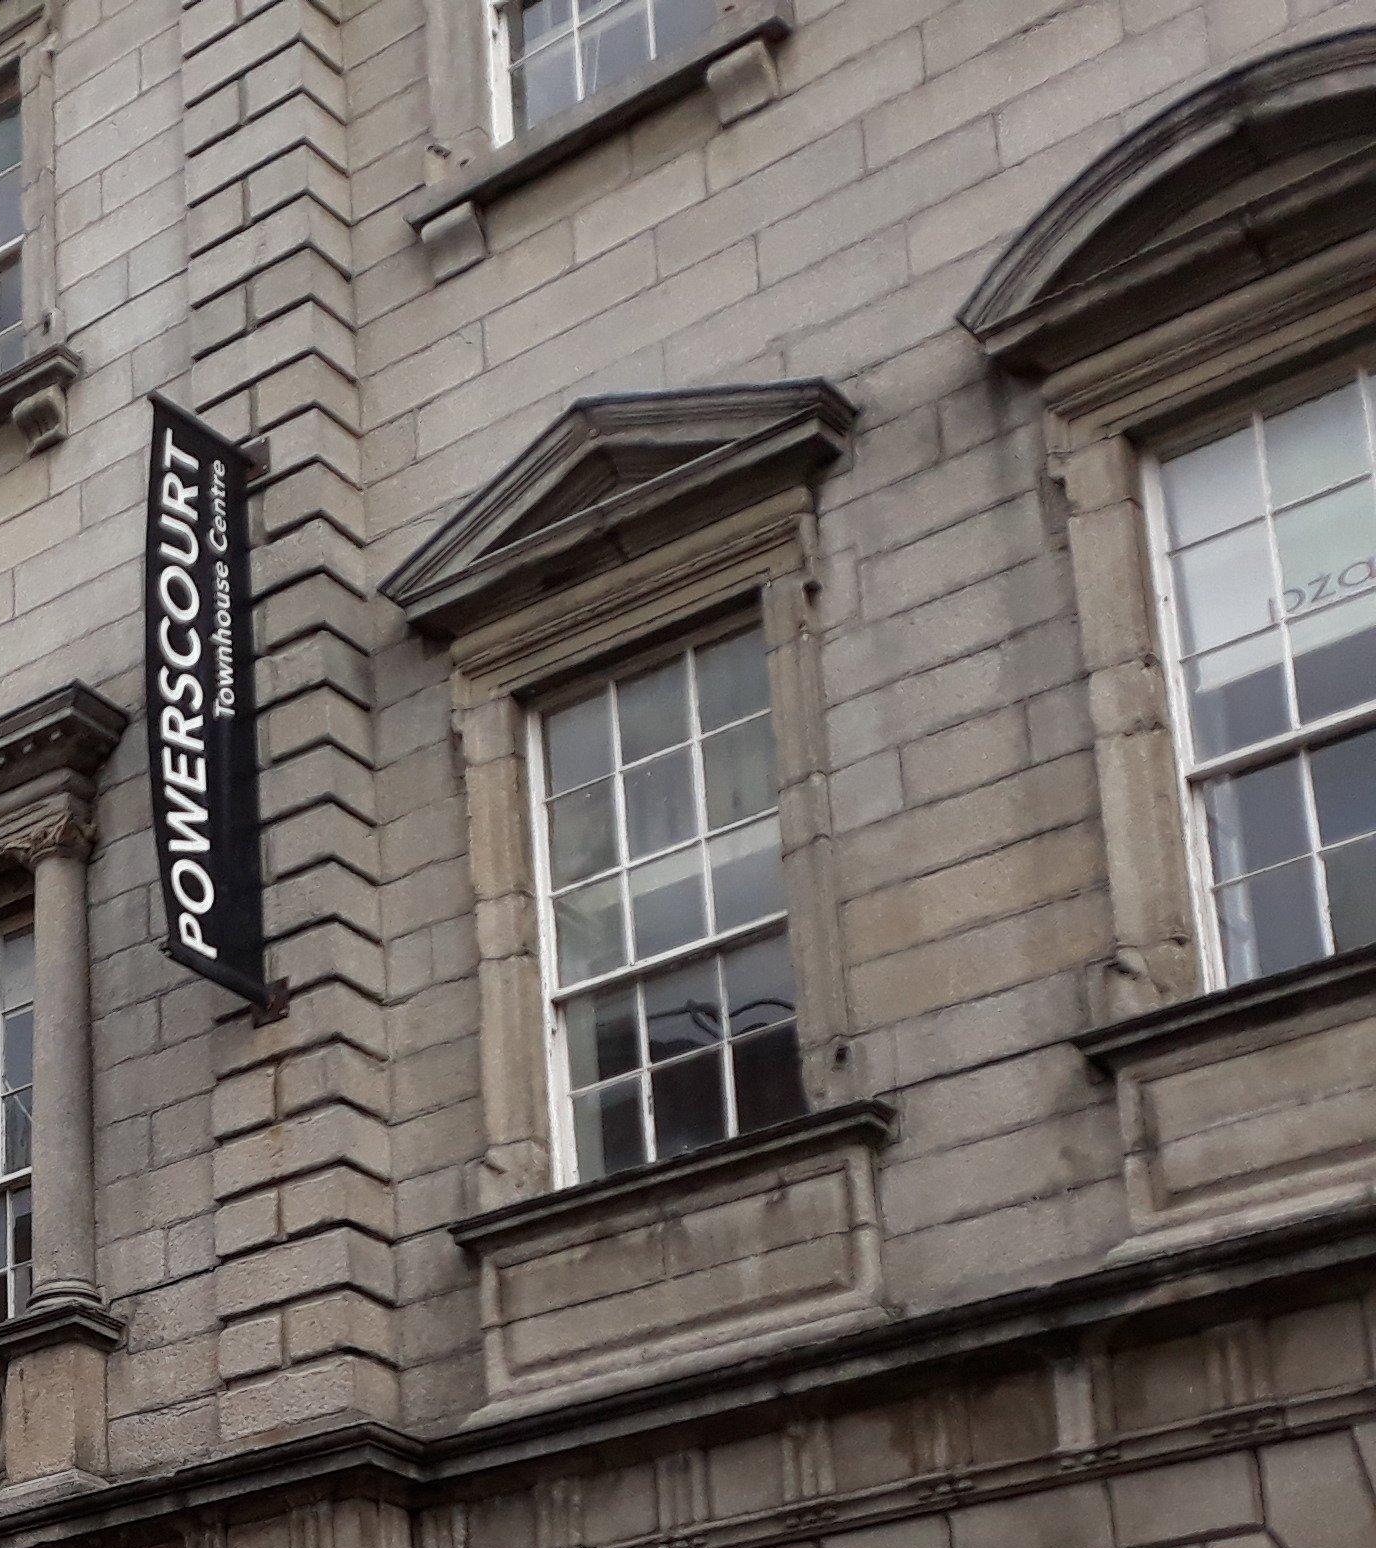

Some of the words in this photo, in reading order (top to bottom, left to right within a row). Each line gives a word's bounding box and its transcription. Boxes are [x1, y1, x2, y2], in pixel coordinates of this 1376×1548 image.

[209, 458, 228, 554] Centre
[157, 427, 219, 960] POWERSCOURT
[210, 560, 234, 718] Townhouse
